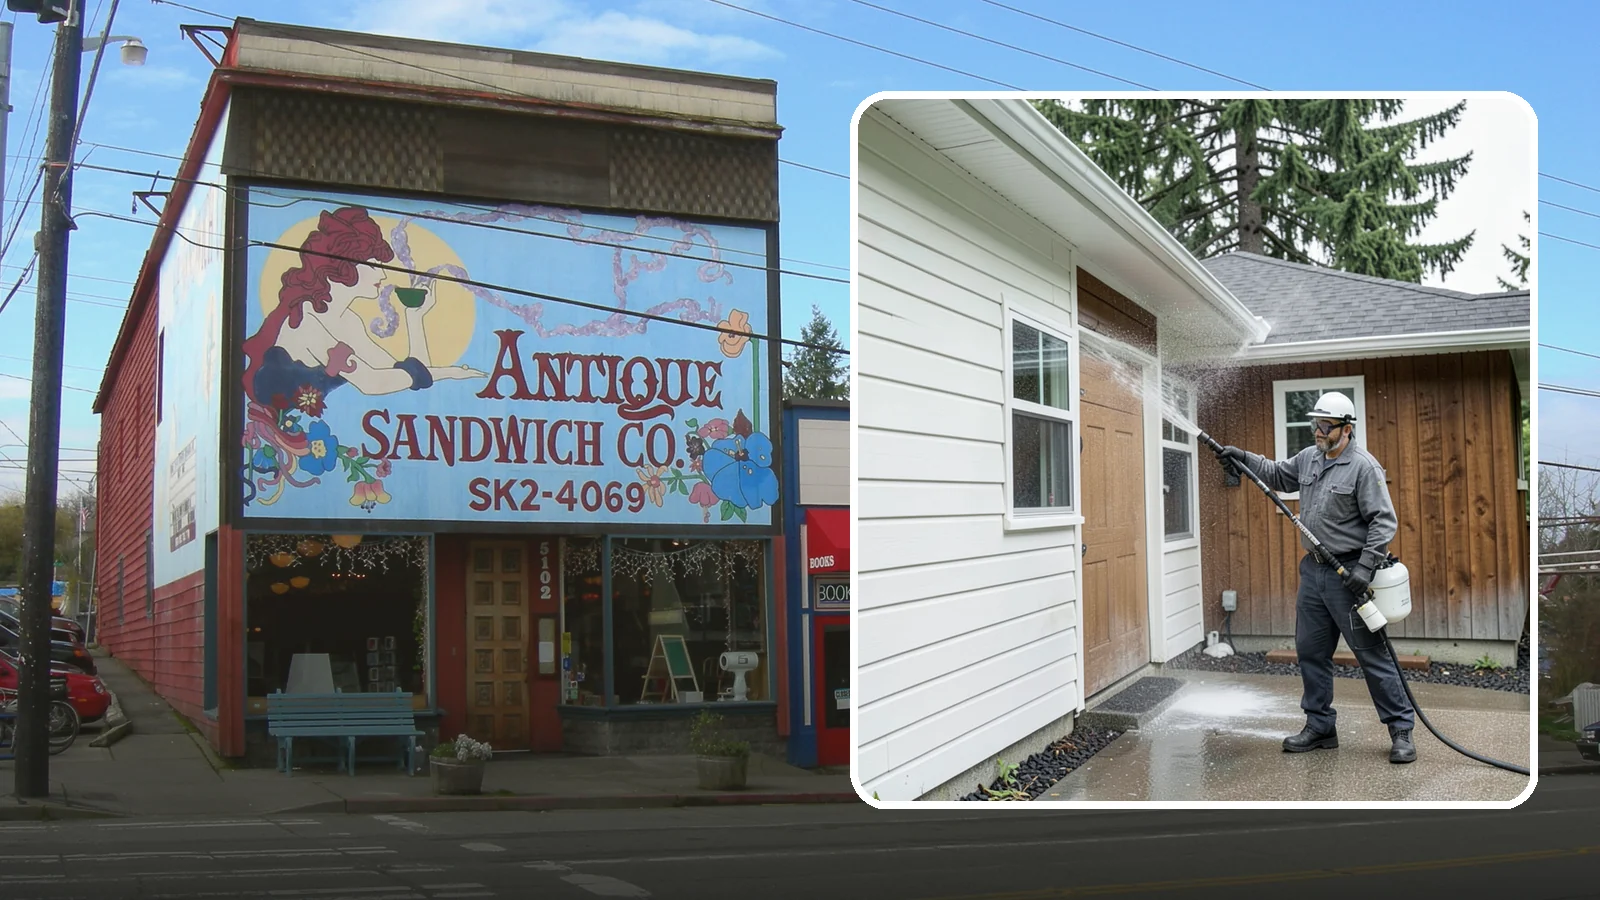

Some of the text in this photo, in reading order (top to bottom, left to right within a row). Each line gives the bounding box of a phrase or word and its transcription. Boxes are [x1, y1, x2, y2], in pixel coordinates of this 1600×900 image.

[476, 329, 723, 421] ANTIQUE
[361, 408, 685, 468] SANDWICH CO.
[468, 477, 646, 513] SK2-4069
[540, 542, 551, 599] 5102
[809, 555, 835, 569] BOOKS
